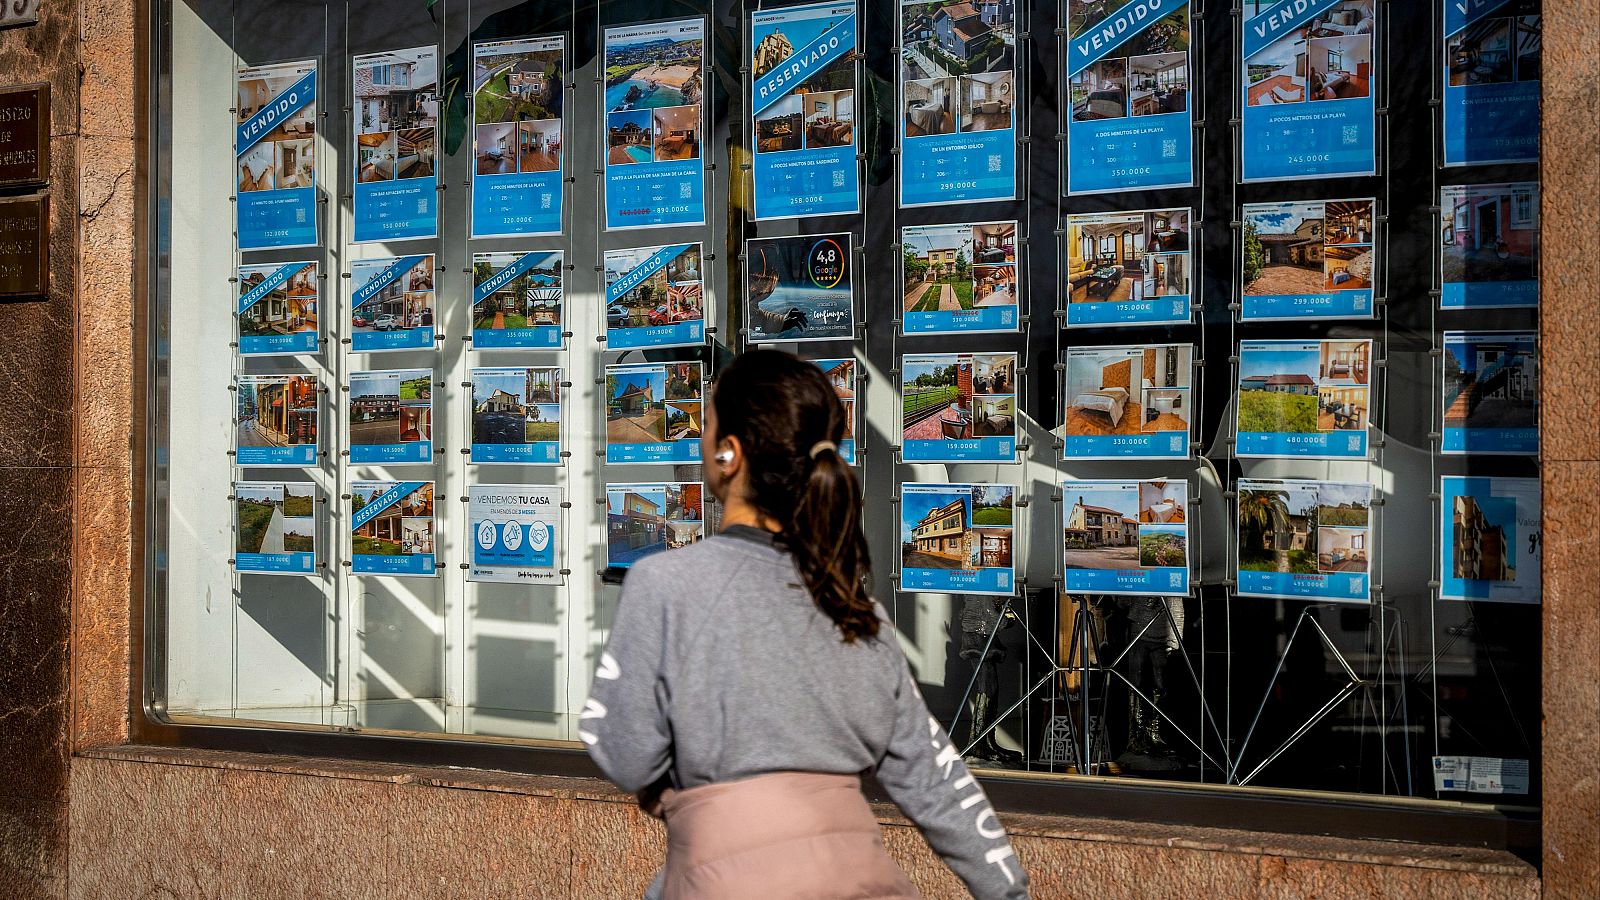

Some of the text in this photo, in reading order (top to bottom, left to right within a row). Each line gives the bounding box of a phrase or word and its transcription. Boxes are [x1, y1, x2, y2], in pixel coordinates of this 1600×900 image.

[1077, 0, 1161, 56] VENDIDO
[759, 36, 839, 98] RESERVADO
[242, 92, 298, 140] VENDIDO
[1288, 154, 1330, 163] 245.000€
[1111, 167, 1150, 176] 350.000€
[940, 181, 977, 190] 299.000€
[790, 196, 823, 204] 258.000€
[657, 205, 689, 213] 890.000€
[503, 216, 532, 224] 320.000€
[816, 249, 836, 264] 4,8
[814, 264, 838, 275] Google
[481, 266, 517, 294] VENDIDO
[612, 256, 661, 296] RESERVADO
[243, 272, 284, 306] RESERVADO
[359, 271, 393, 298] VENDIDO
[1293, 297, 1331, 305] 299.000€
[1286, 436, 1325, 444] 480.000€
[477, 495, 550, 504] VENDEMOS TU CASA
[356, 490, 399, 523] RESERVADO
